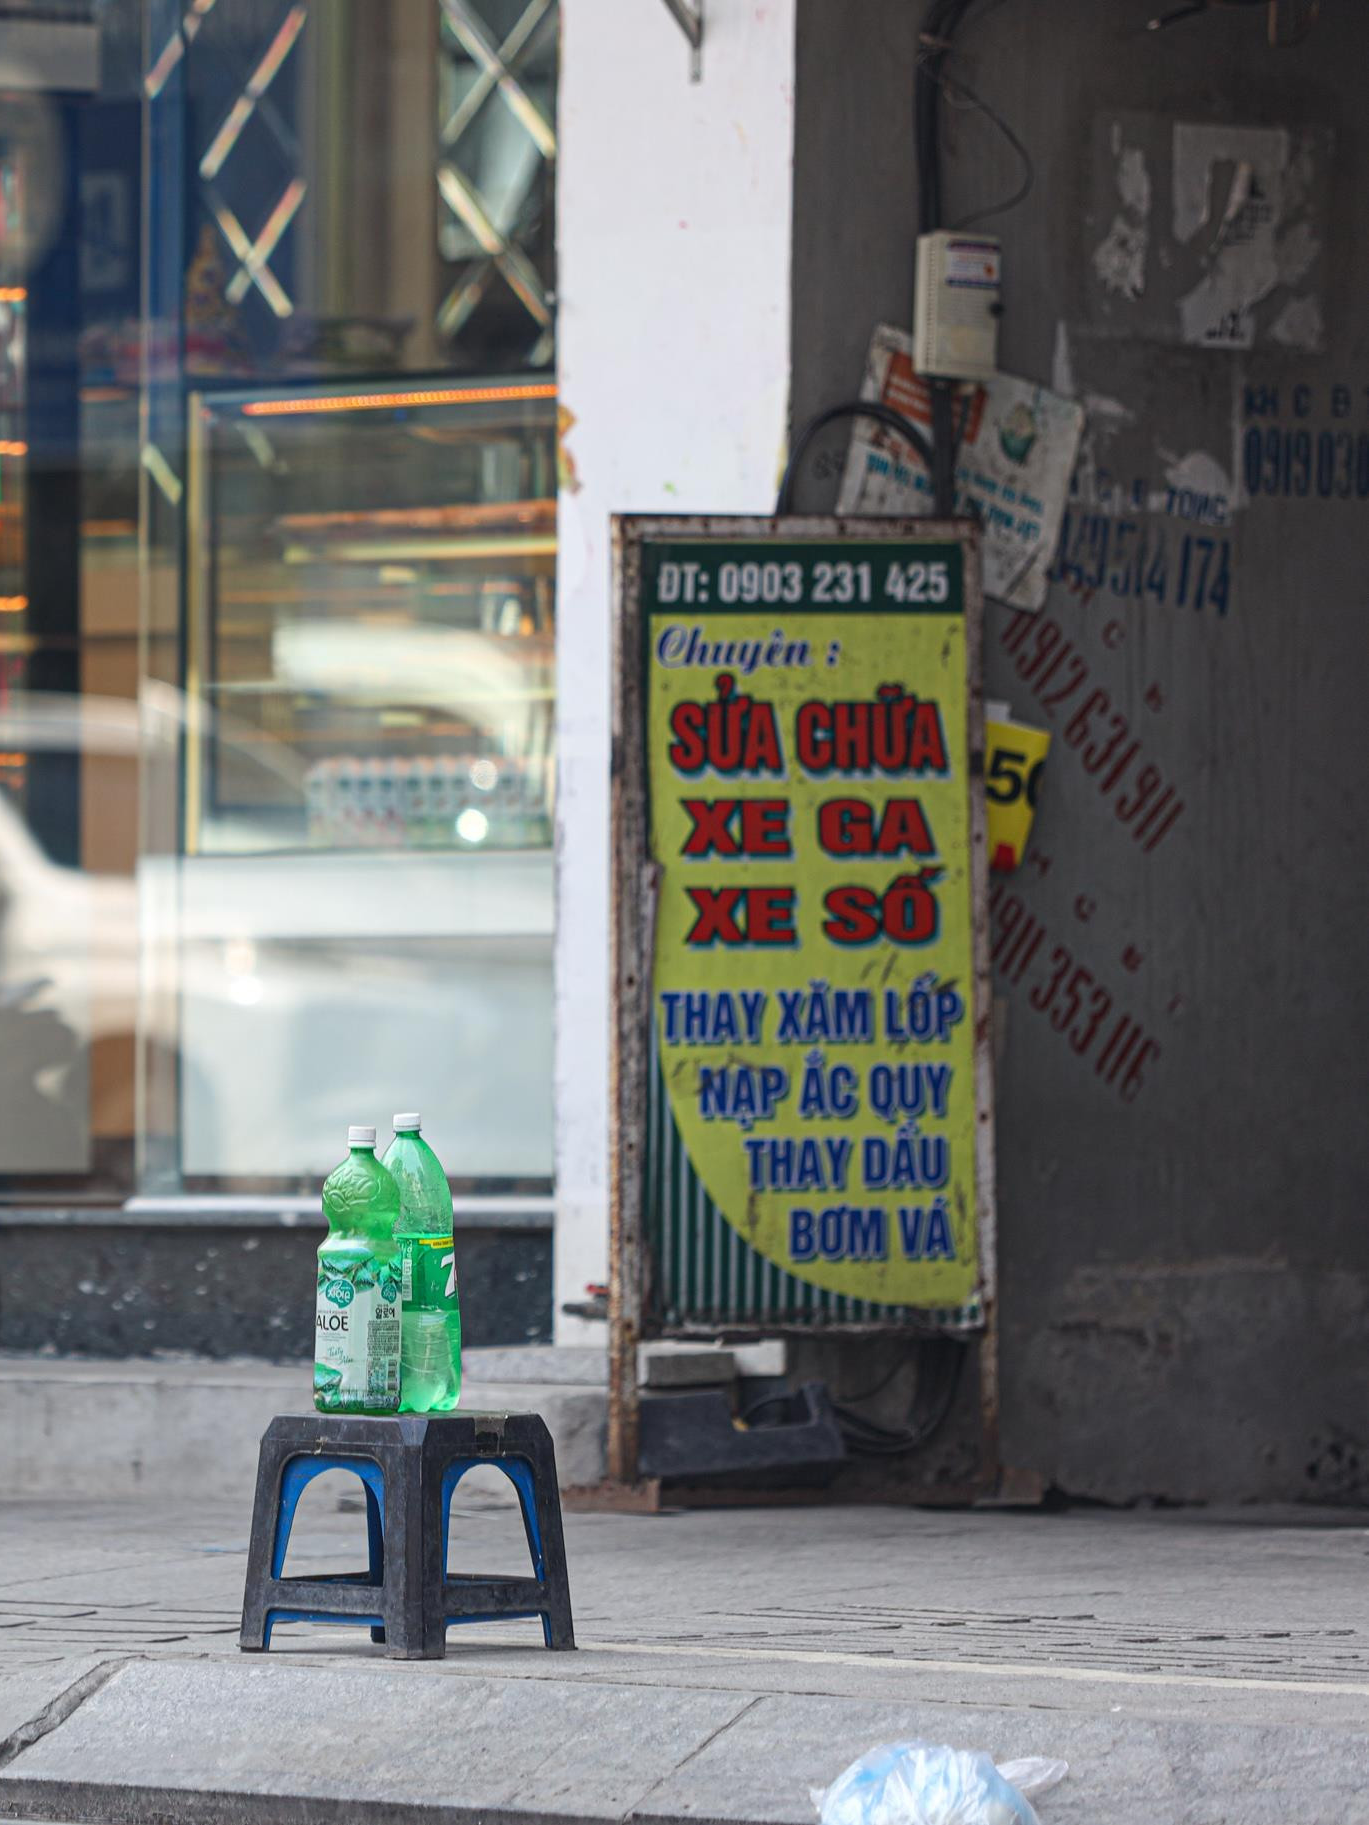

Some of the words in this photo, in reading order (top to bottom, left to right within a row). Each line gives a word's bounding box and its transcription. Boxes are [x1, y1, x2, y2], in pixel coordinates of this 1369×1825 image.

[657, 563, 710, 603] ĐT:
[717, 563, 803, 603] 0903
[811, 563, 872, 603] 231
[884, 563, 950, 603] 425
[667, 672, 788, 781] SỬA
[794, 681, 954, 782] CHỮA
[679, 798, 797, 863] XE
[816, 798, 939, 863] GA
[683, 887, 800, 950] XE
[821, 866, 944, 950] SỐ
[660, 990, 767, 1048] THAY
[883, 971, 964, 1044] LỐP
[698, 1065, 791, 1131] NẠP
[868, 1062, 955, 1125] QUY
[743, 1137, 854, 1192] THAY
[788, 1206, 889, 1264] BƠM
[897, 1195, 957, 1262] VÁ
[316, 1315, 349, 1332] ALOE
